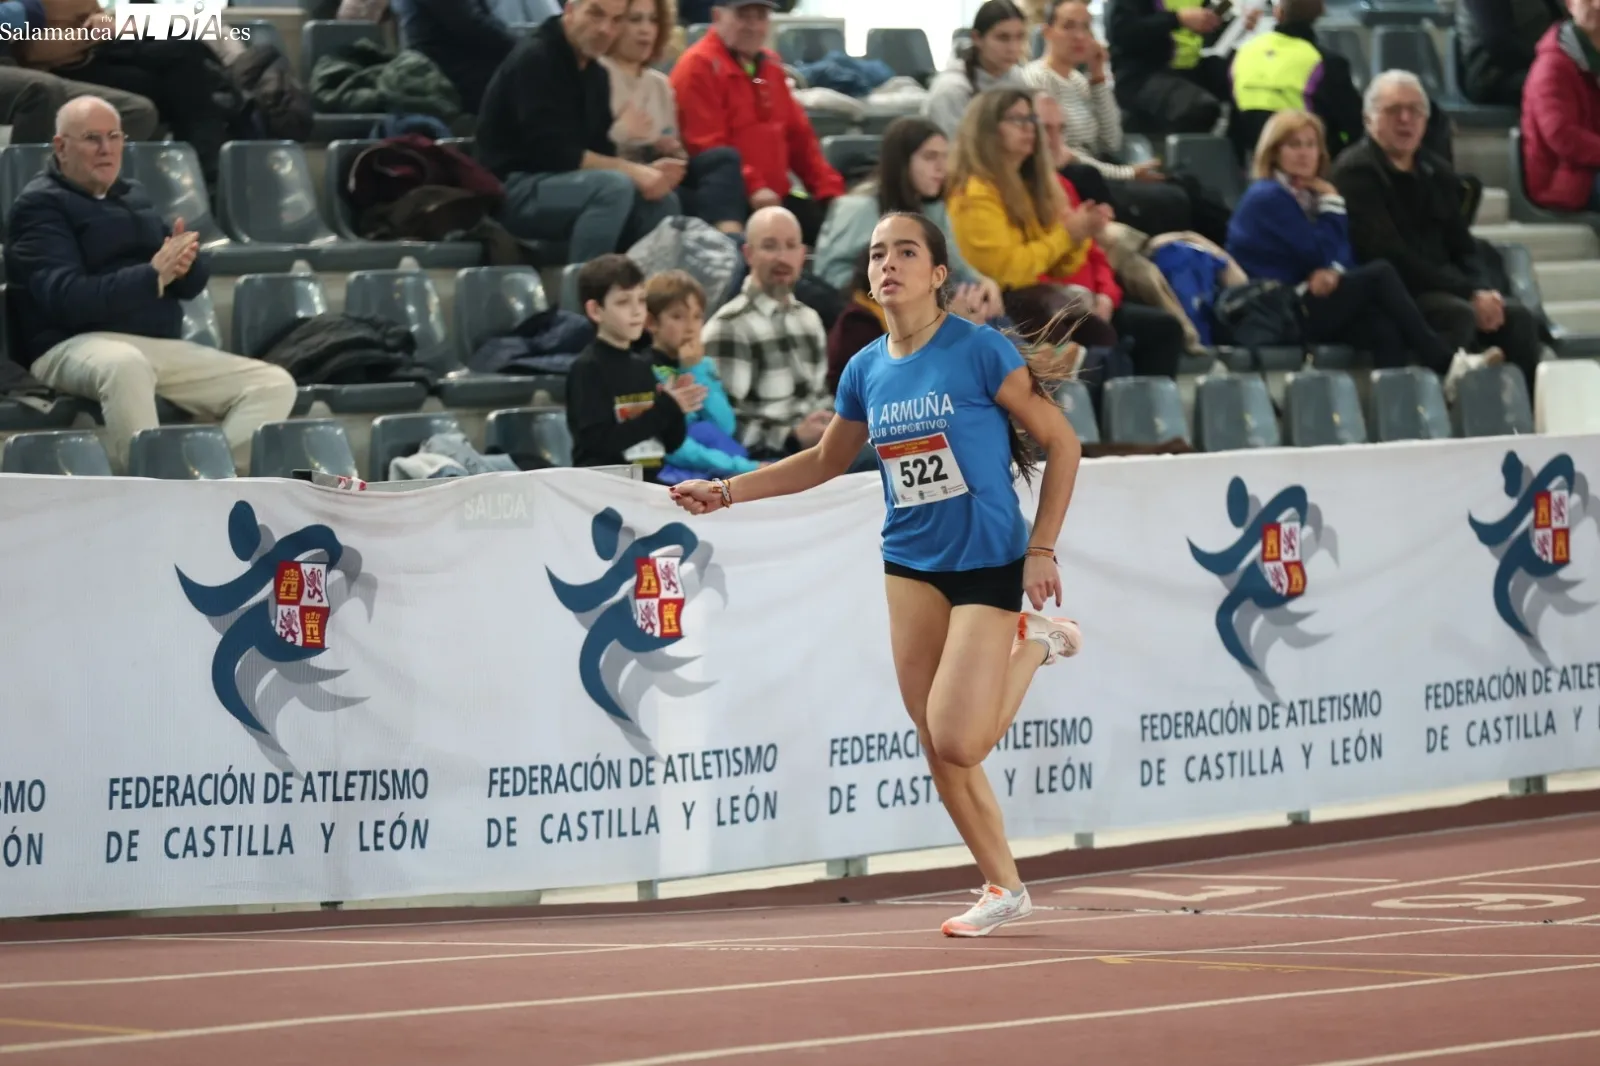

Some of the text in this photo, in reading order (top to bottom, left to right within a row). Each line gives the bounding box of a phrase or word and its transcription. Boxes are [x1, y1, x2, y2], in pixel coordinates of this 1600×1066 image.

[879, 391, 955, 426] ARMUÑA
[870, 429, 887, 438] LUB
[900, 455, 948, 488] 522
[1425, 667, 1527, 711] FEDERACIÓN
[1532, 664, 1552, 694] DE
[1140, 690, 1382, 742] FEDERACIÓN DE ATLETISMO
[1426, 705, 1583, 754] DE CASTILLA Y
[487, 743, 778, 799] FEDERACIÓN DE ATLETISMO
[829, 728, 920, 767] FEDERACI
[1140, 733, 1382, 787] DE CASTILLA Y LEÓN
[0, 778, 46, 814] MO
[108, 764, 429, 811] FEDERACIÓN DE ATLETISMO
[829, 783, 856, 815] DE
[1004, 768, 1016, 797] Y
[1035, 762, 1092, 795] LEÓN
[105, 811, 429, 864] DE CASTILLA Y LEÓN
[486, 787, 777, 849] DE CASTILLA Y LEÓN
